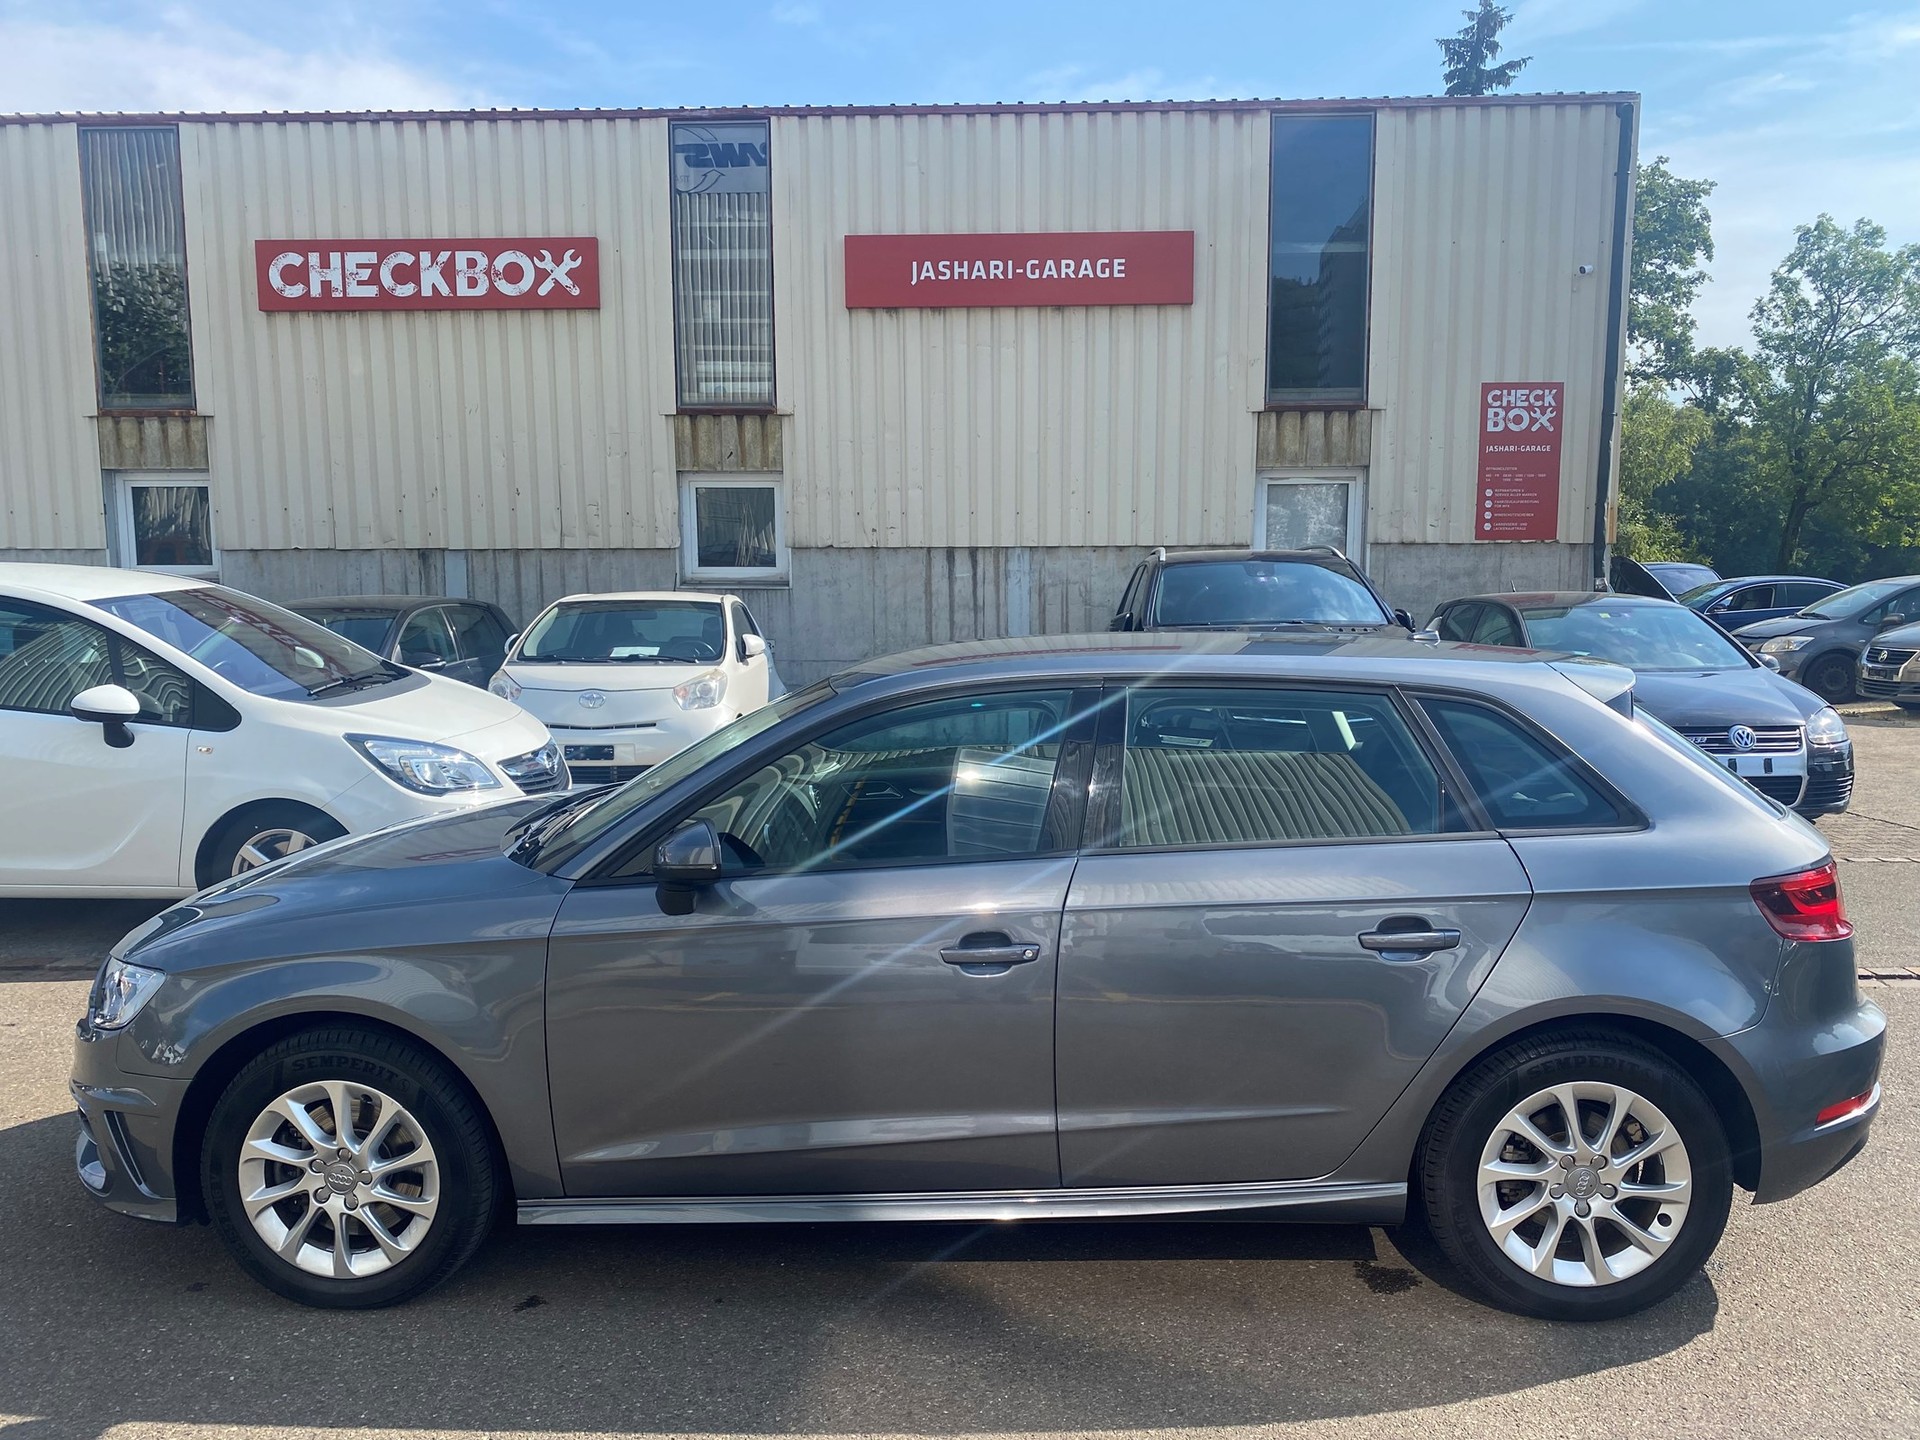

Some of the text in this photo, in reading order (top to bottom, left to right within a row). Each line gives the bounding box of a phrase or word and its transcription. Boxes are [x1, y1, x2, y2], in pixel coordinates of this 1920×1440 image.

[268, 249, 583, 298] CHECKBOX
[911, 258, 1126, 286] JASHARI-GARAGE
[1487, 389, 1557, 407] CHECK
[1486, 407, 1557, 432] BOX
[1486, 445, 1551, 453] JASHARI-GARAGE
[292, 1055, 399, 1082] SEMPERIT
